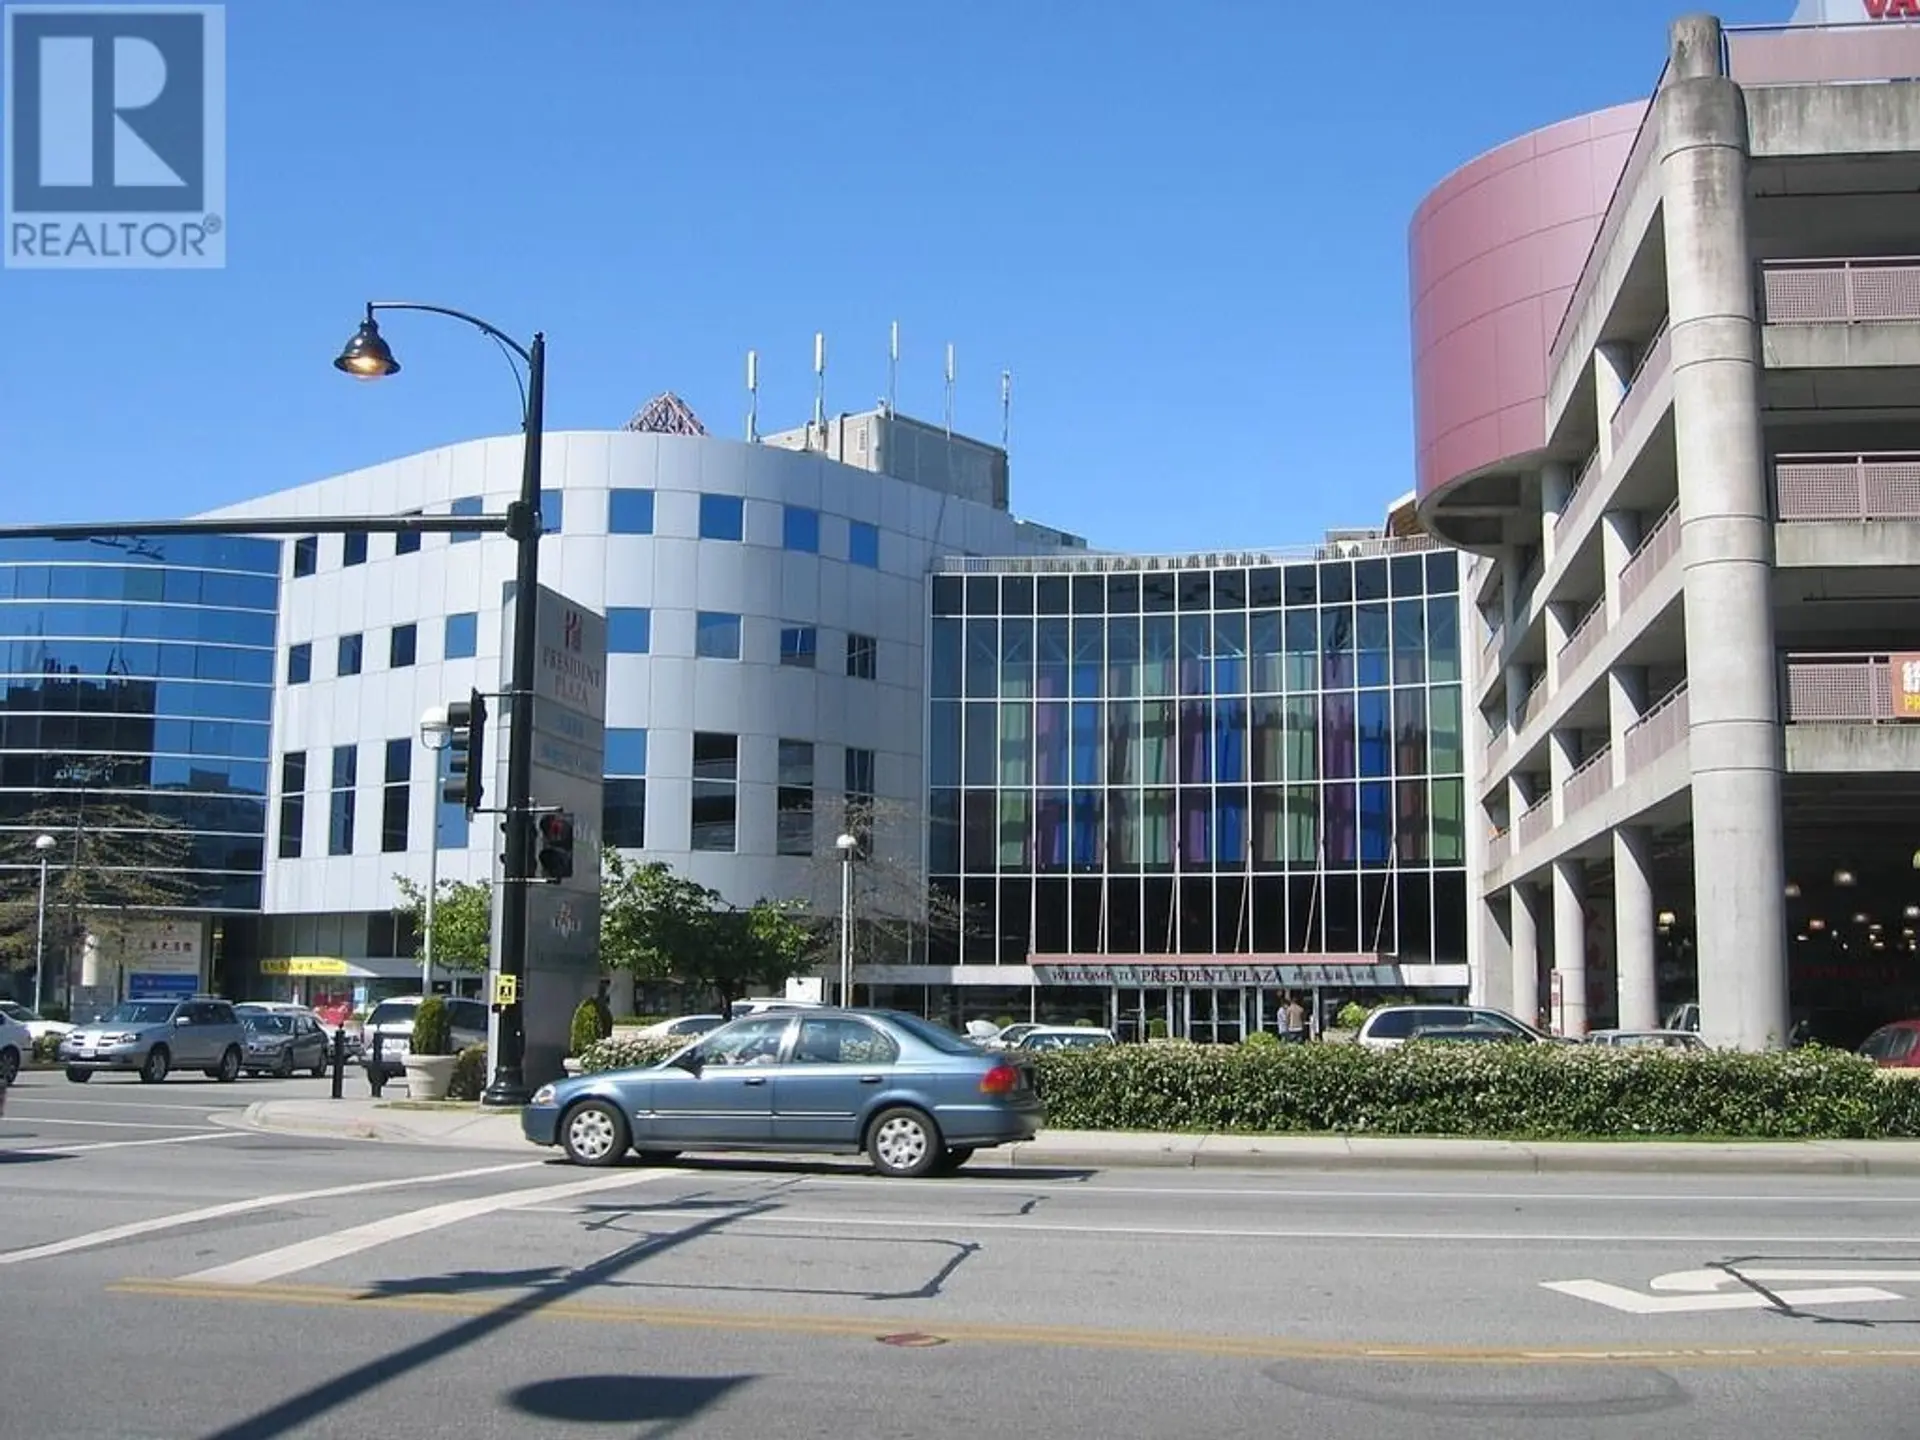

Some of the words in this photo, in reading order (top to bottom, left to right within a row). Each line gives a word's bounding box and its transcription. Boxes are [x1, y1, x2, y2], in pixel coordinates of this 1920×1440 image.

[543, 645, 600, 690] PRESIDENT
[555, 673, 589, 707] PLAZA
[1118, 971, 1136, 981] TO
[1141, 968, 1224, 983] PRESIDENT
[1232, 969, 1283, 984] PLAZA
